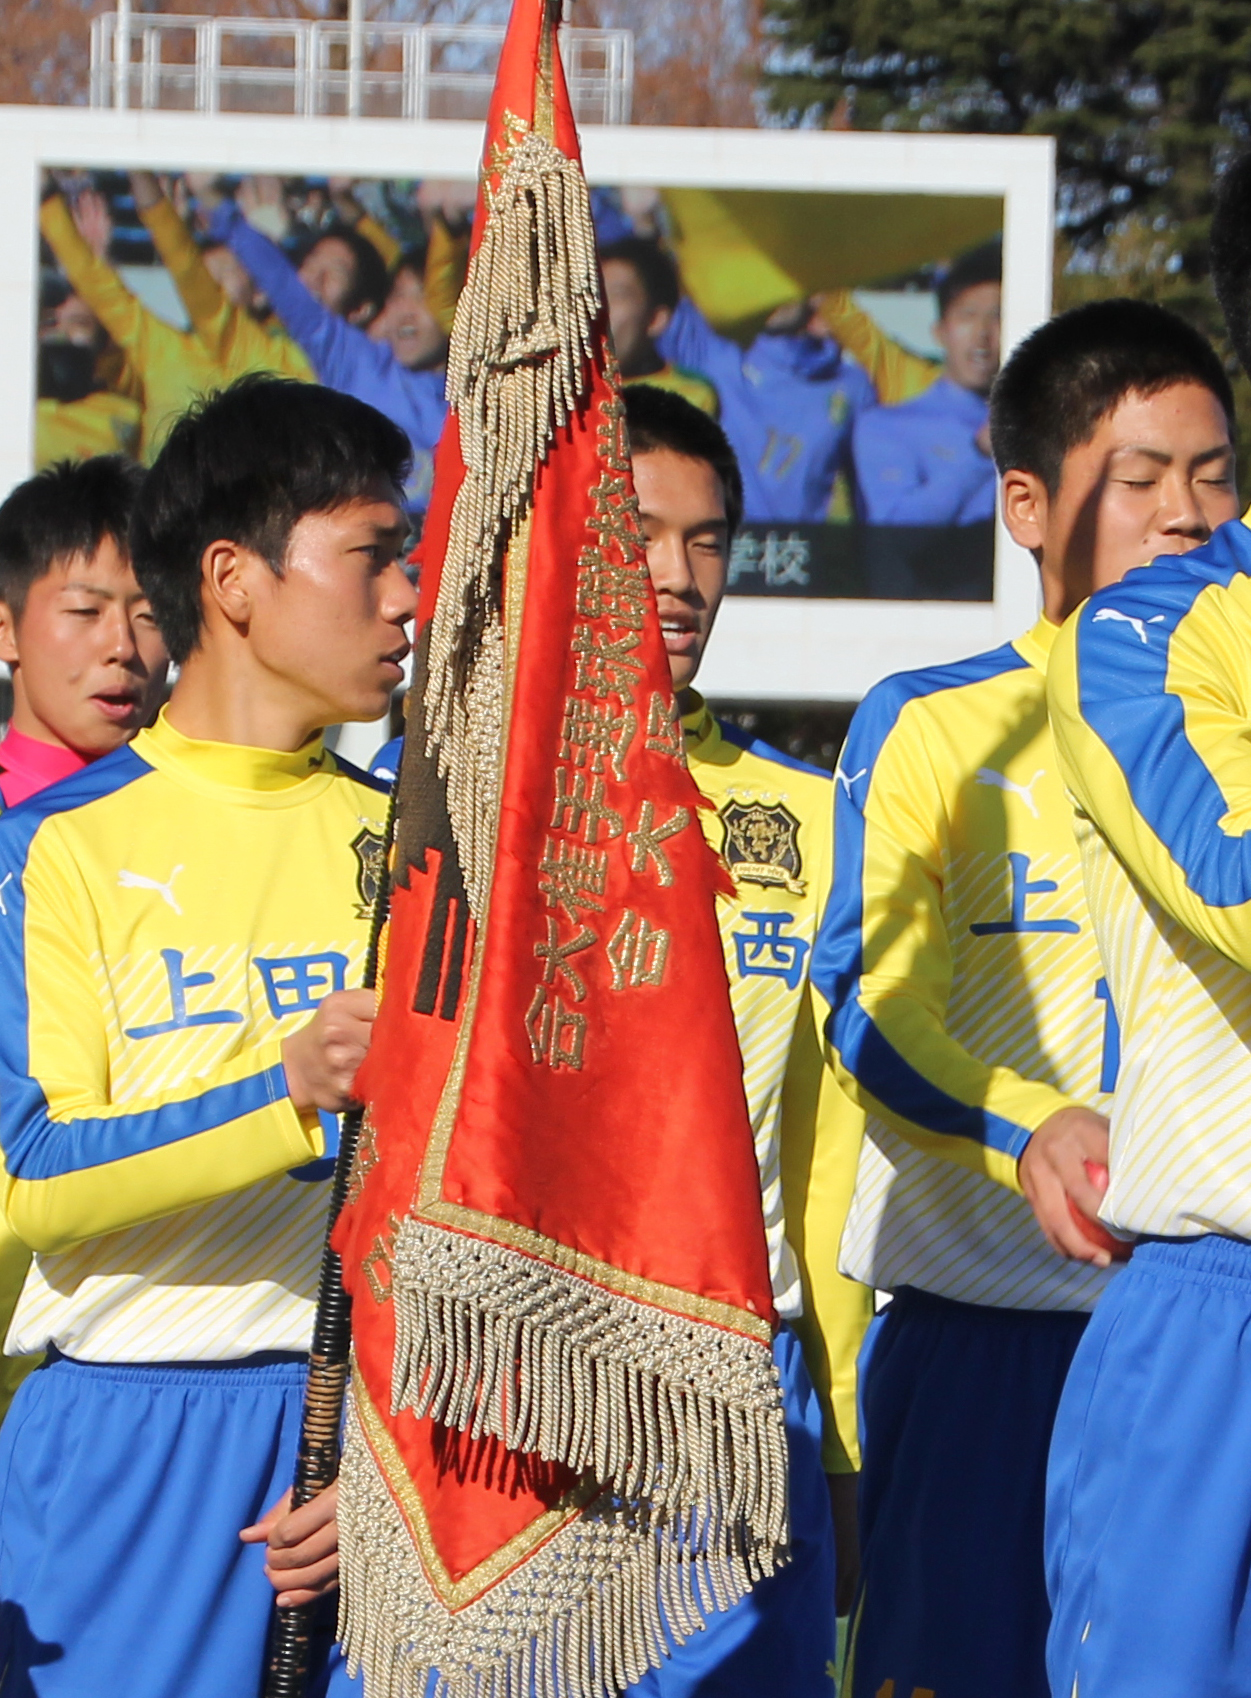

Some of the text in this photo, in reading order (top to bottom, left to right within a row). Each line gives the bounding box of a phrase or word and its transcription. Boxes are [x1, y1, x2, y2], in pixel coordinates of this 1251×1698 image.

[968, 852, 1081, 937] 上
[732, 911, 811, 990] 西
[124, 948, 349, 1041] 上田
